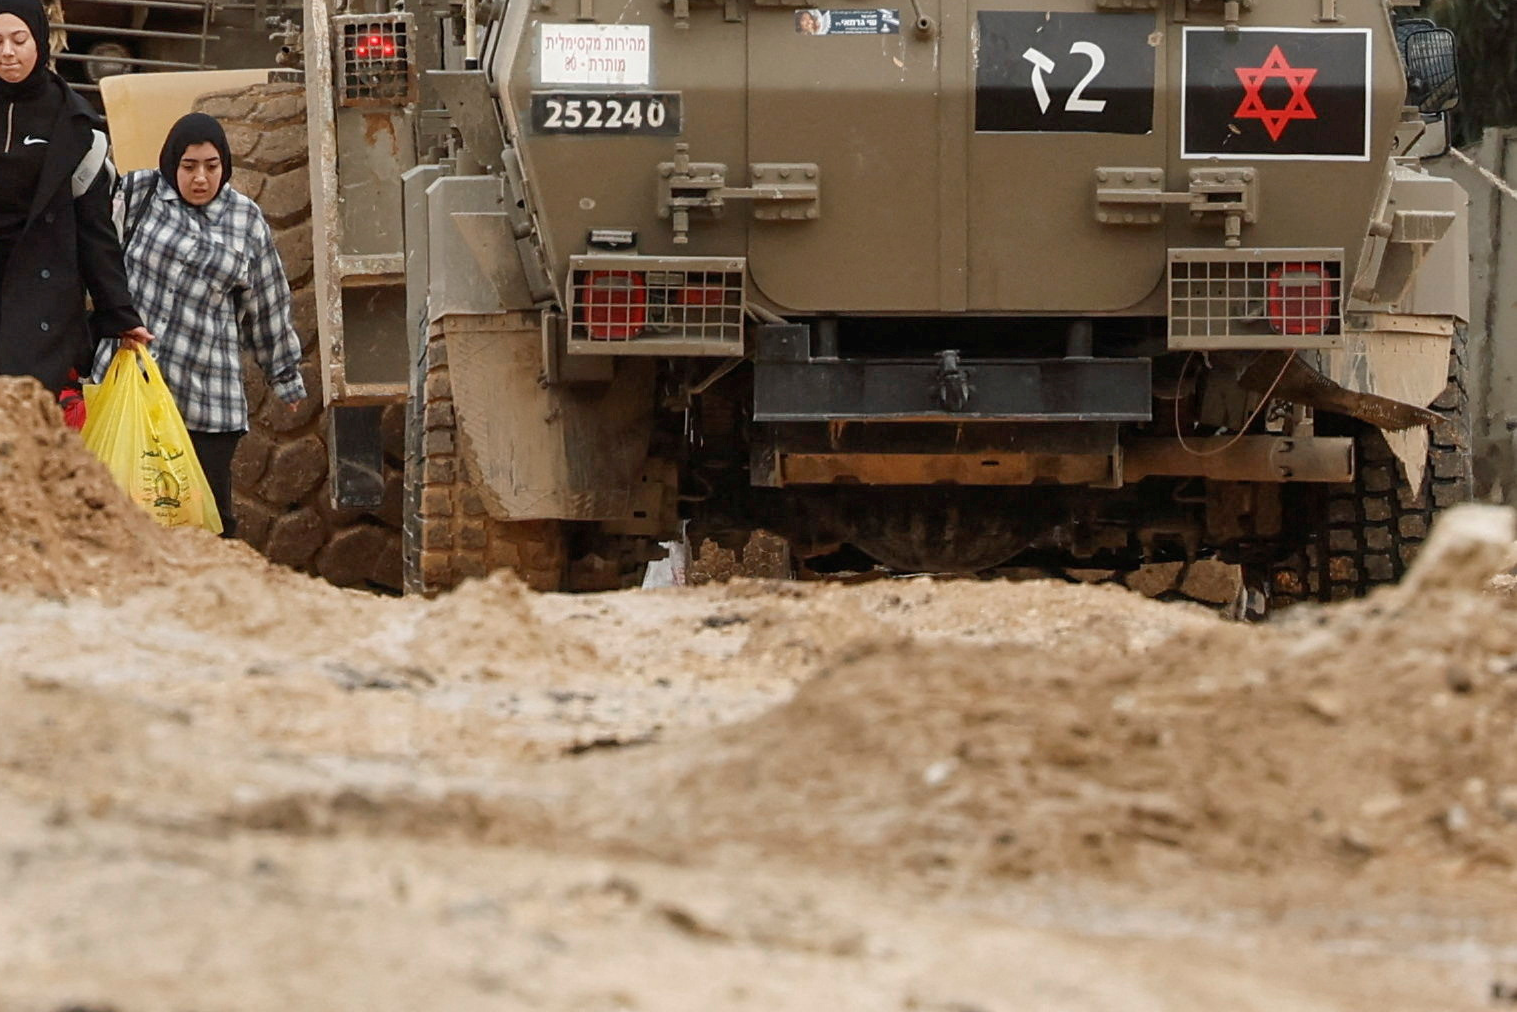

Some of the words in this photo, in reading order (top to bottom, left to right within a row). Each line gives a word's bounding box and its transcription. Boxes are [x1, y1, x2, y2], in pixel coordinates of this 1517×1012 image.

[545, 33, 601, 54] מקסימלית
[605, 37, 646, 51] מהירות
[588, 58, 626, 72] מותרת
[543, 99, 665, 128] 252240
